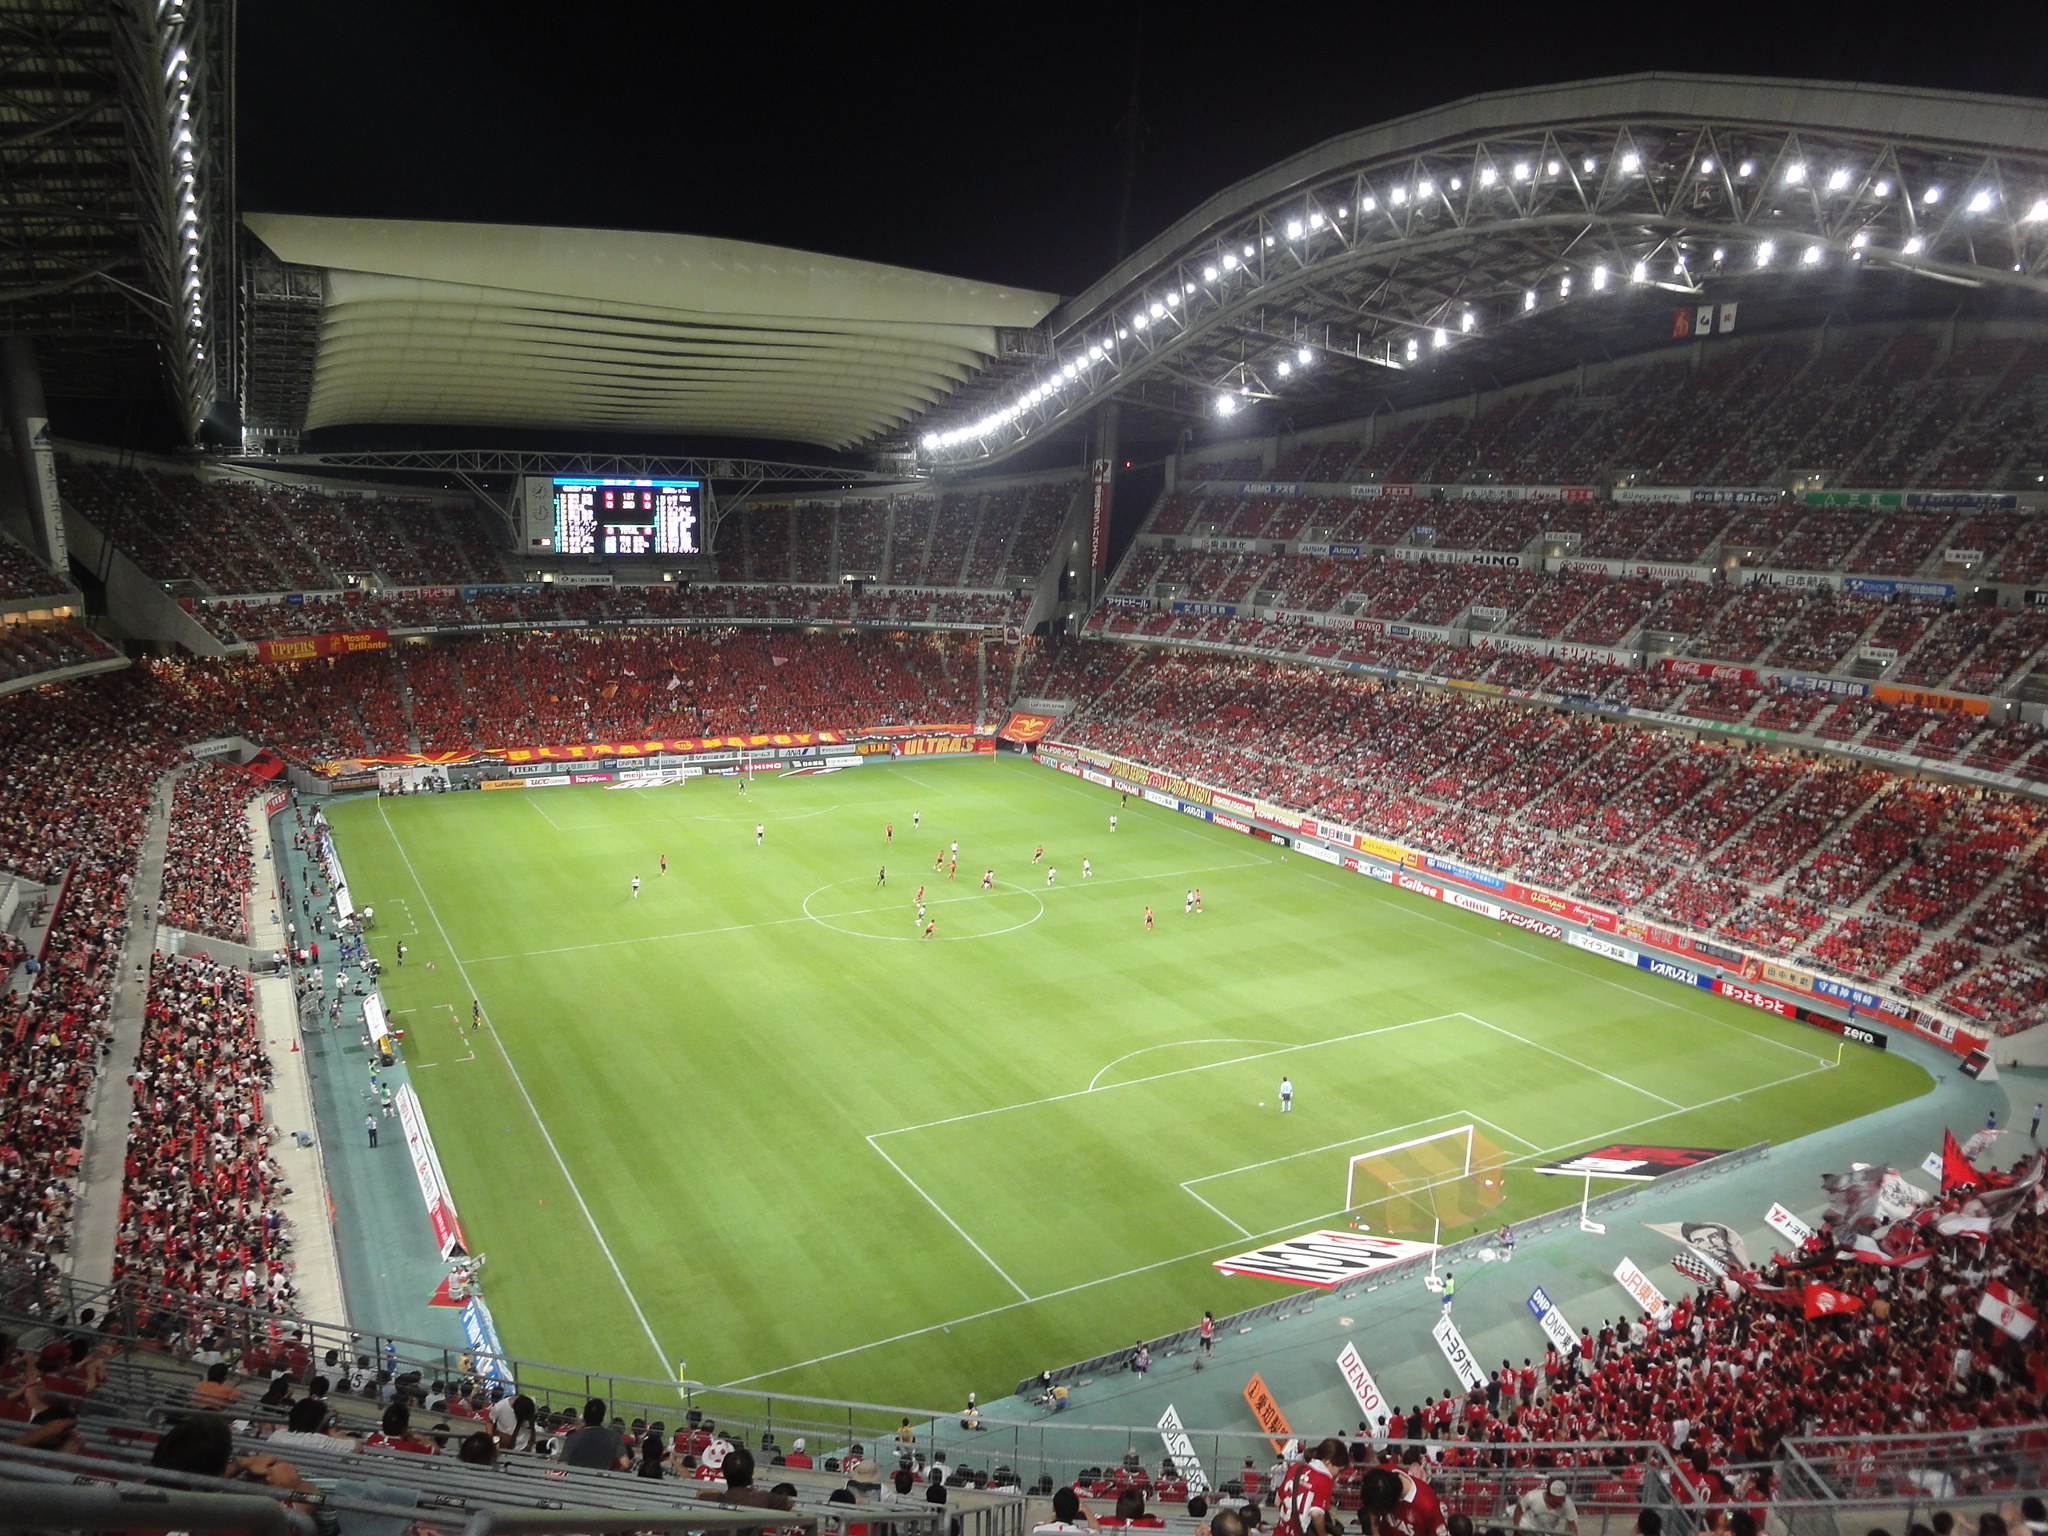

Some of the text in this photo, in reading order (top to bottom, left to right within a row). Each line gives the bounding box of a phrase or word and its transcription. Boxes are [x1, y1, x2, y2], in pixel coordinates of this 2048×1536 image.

[1472, 554, 1519, 567] HINO
[1574, 561, 1608, 571] TOYOTA
[1650, 568, 1697, 578] DAIHATSU
[1356, 621, 1381, 631] DENSO
[342, 634, 371, 642] Rosso
[348, 640, 387, 651] Brillante
[904, 737, 976, 755] ULTRAS
[514, 766, 539, 774] JTEKT
[1114, 780, 1139, 797] KONAMI
[1270, 834, 1285, 846] zero
[1398, 875, 1438, 897] Calbee
[1453, 894, 1489, 914] Canon
[1500, 908, 1562, 940] ウイニングイレブン
[1721, 982, 1785, 1014] ほっともっと
[1843, 1025, 1875, 1044] zero
[1532, 1287, 1551, 1312] DNP
[1620, 1269, 1664, 1315] JR東海
[1341, 1351, 1380, 1411] DENSO
